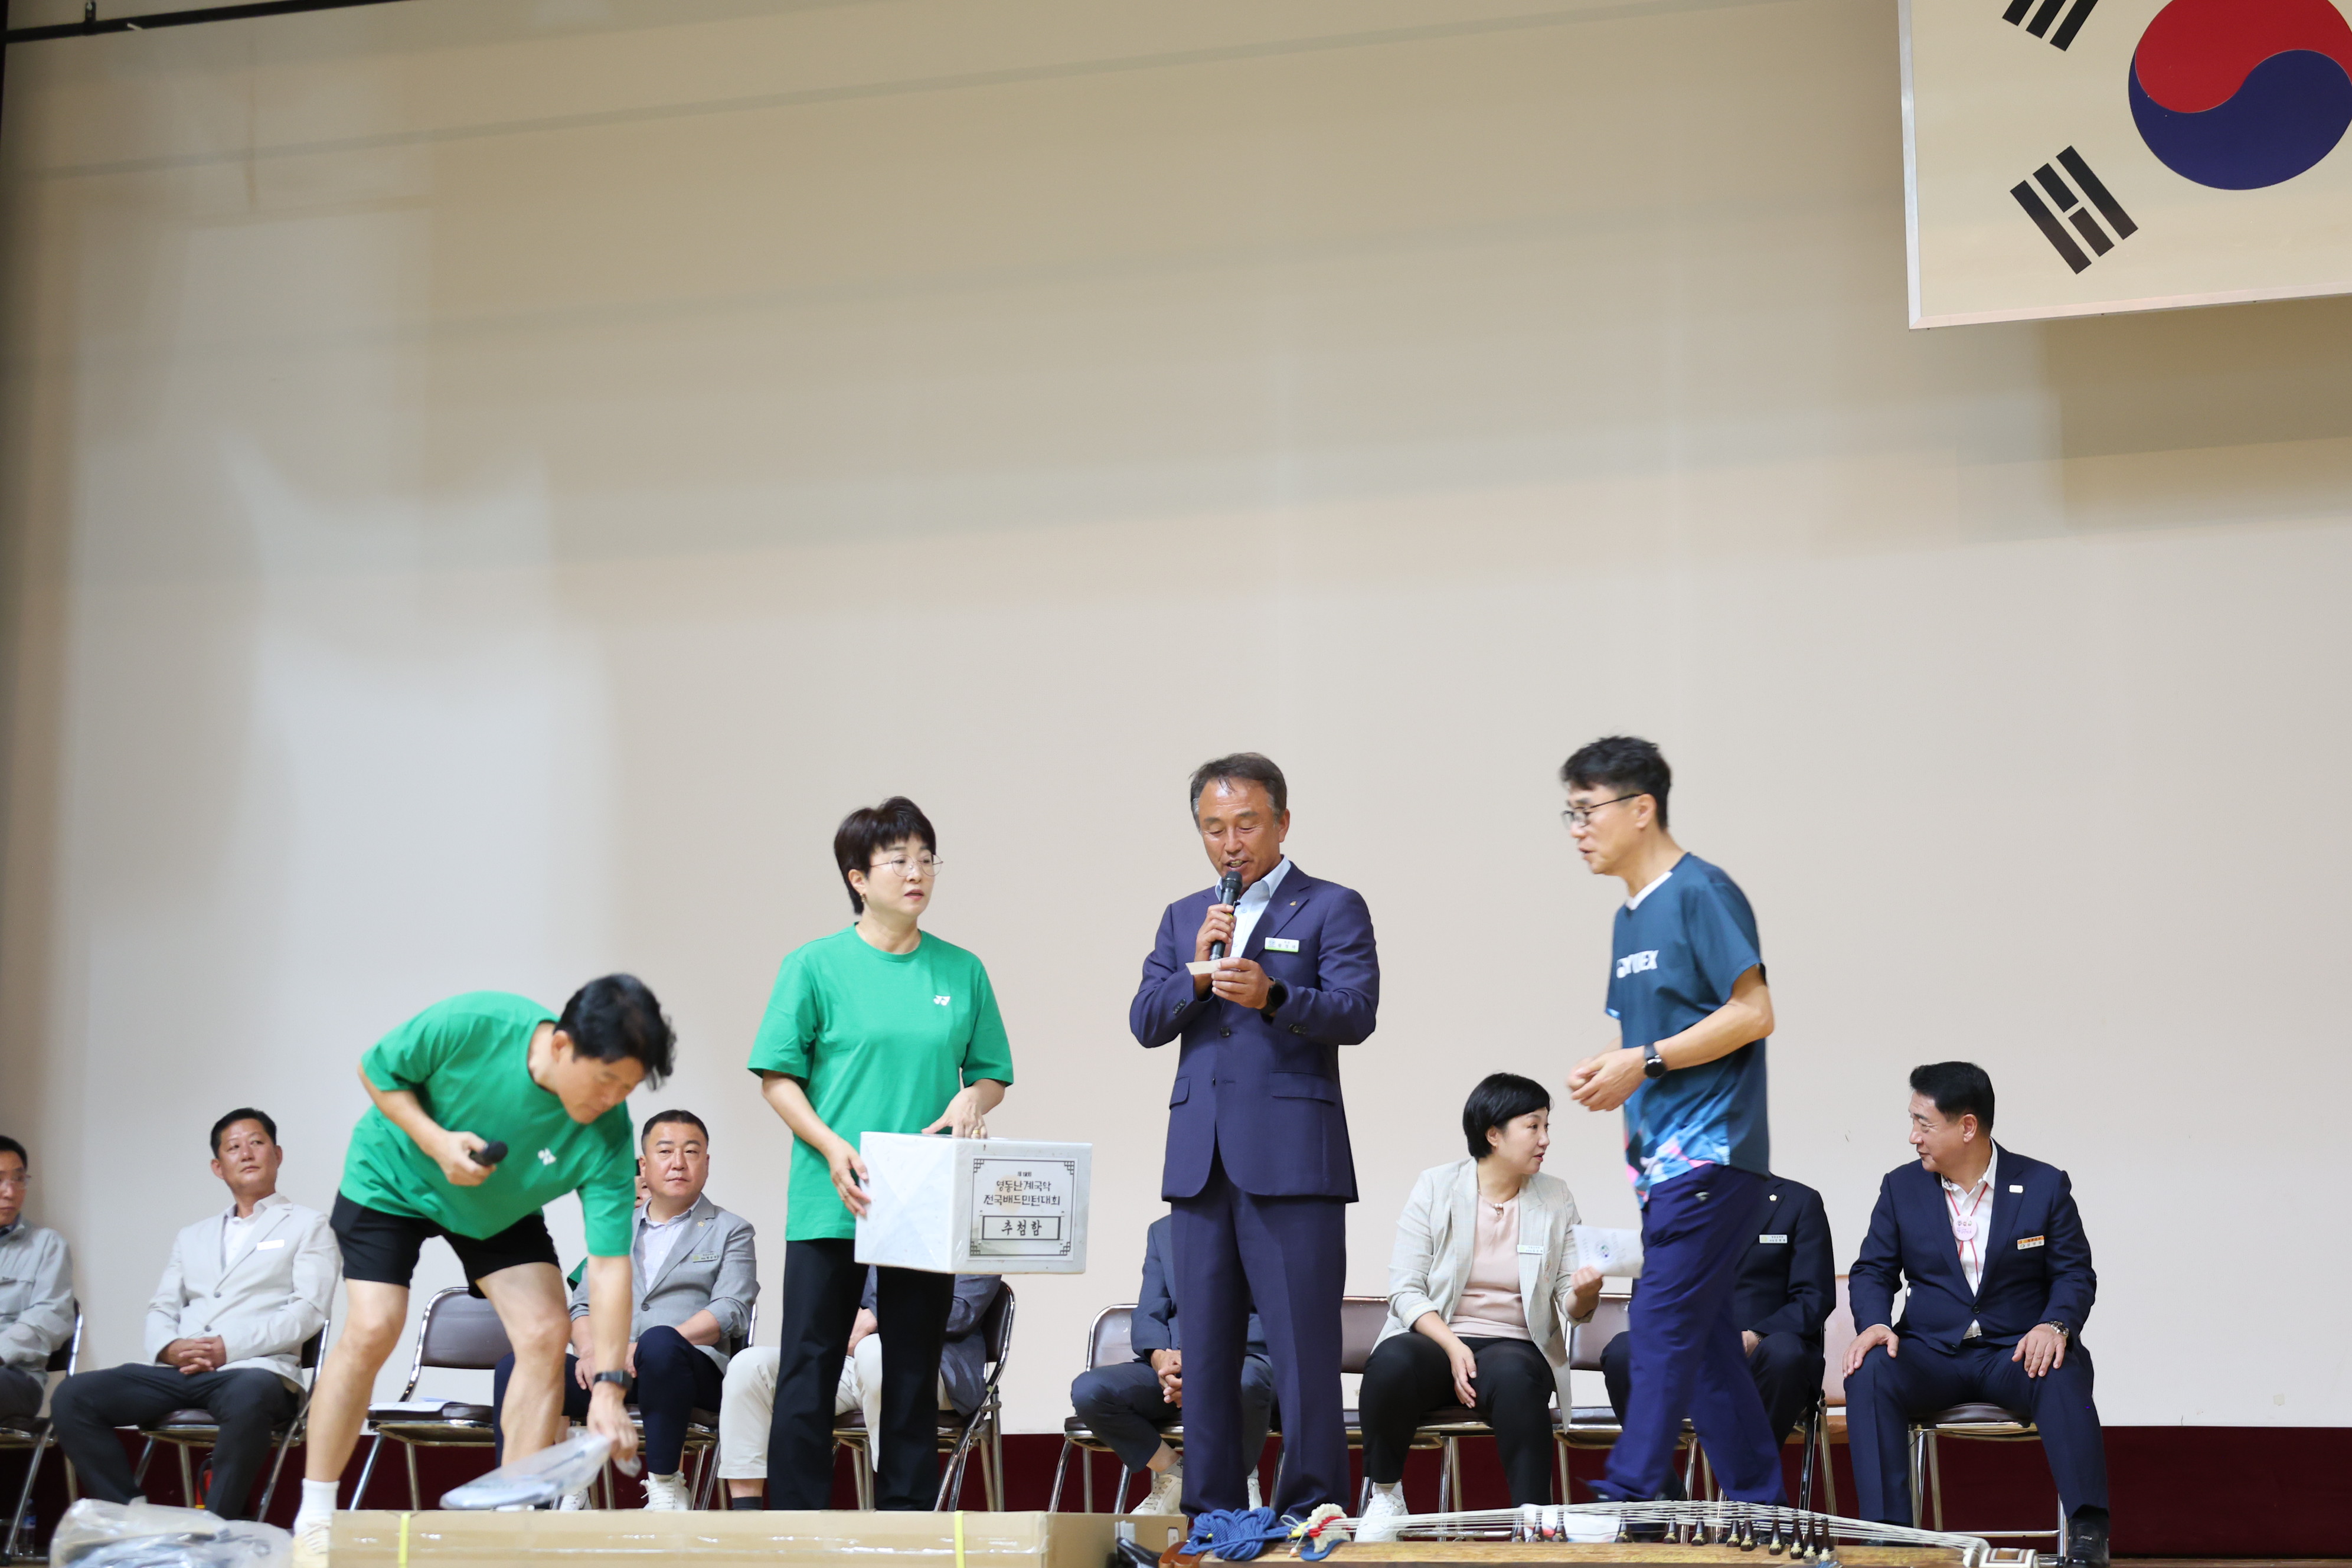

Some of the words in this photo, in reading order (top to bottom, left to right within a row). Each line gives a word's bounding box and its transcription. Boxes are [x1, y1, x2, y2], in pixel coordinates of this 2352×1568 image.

[996, 1180, 1051, 1193] 영동난계국악
[984, 1194, 1060, 1206] 전국배드민턴대회
[1001, 1219, 1042, 1236] 추첨함
